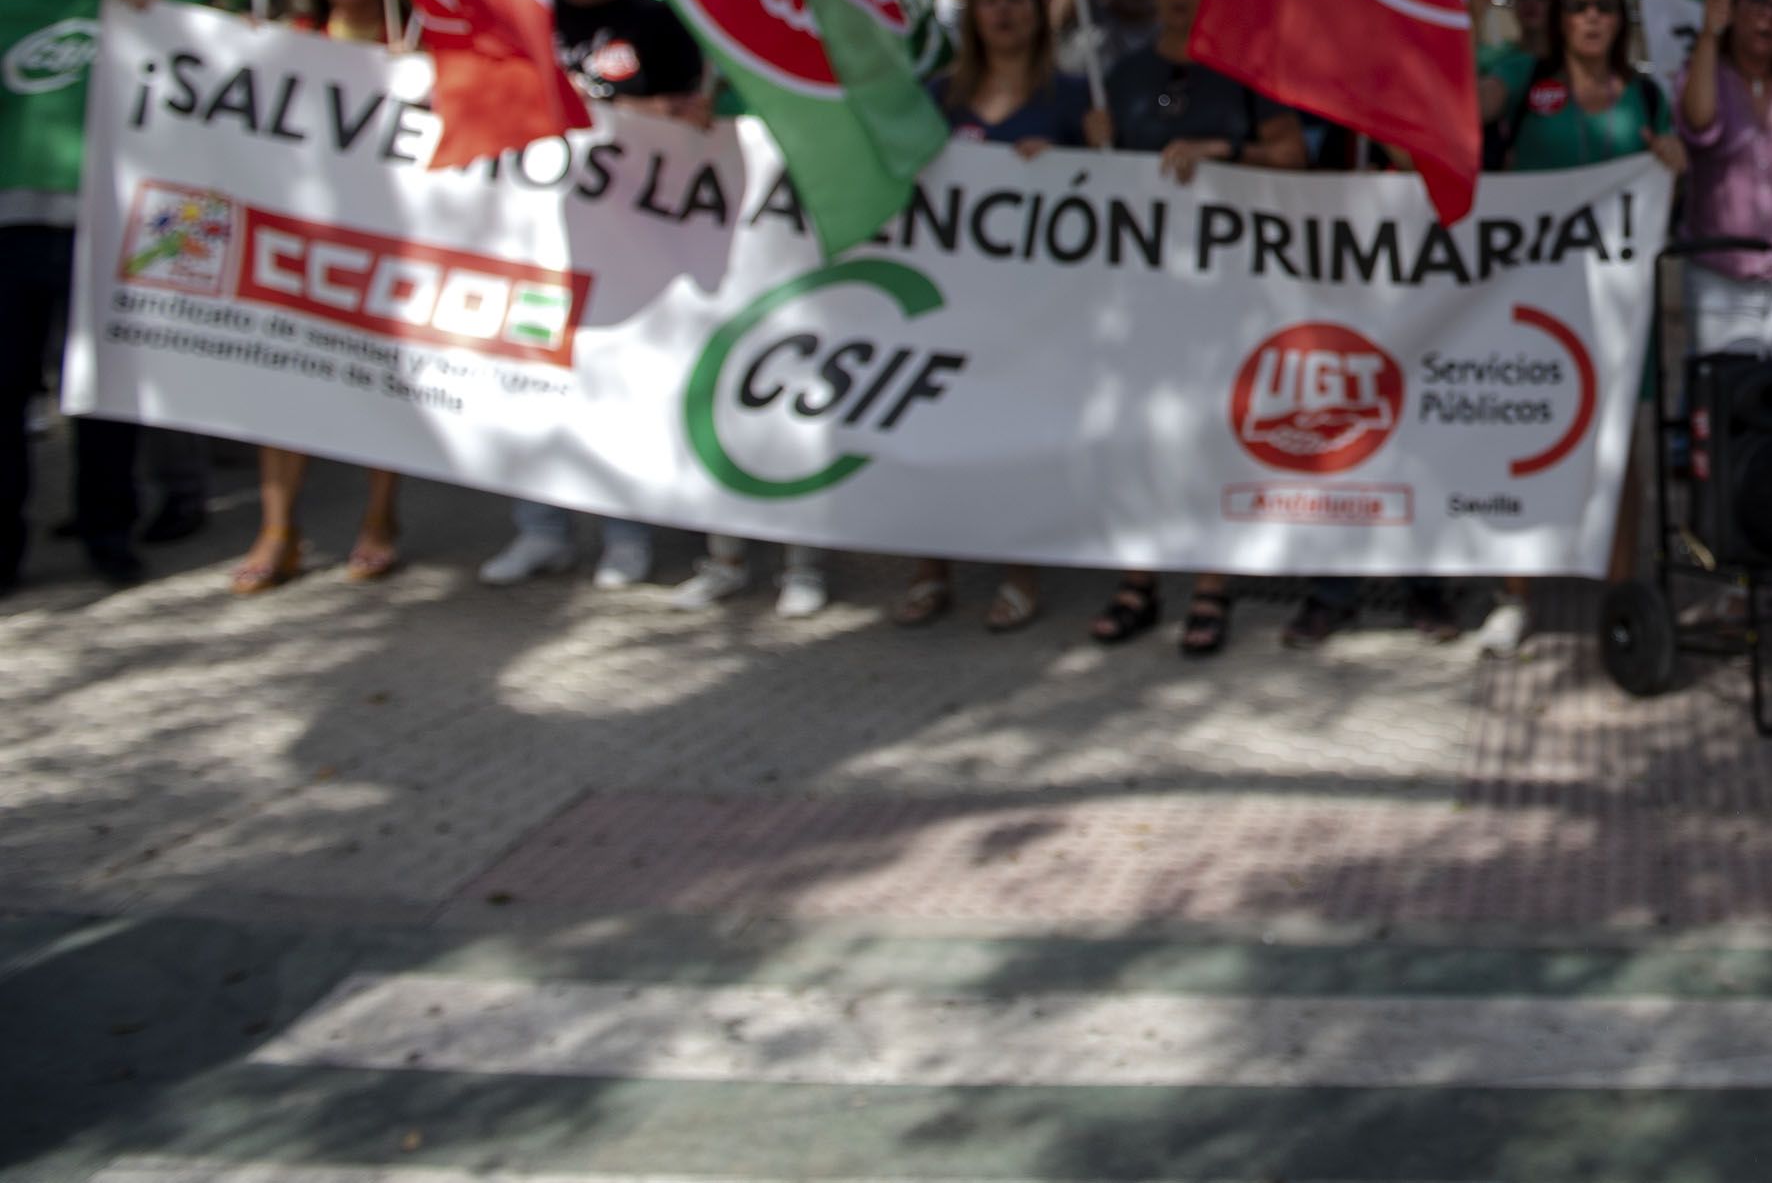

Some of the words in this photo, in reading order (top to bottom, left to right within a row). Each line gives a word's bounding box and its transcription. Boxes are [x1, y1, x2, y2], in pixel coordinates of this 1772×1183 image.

[133, 52, 622, 200] ¡SALVEOS
[637, 156, 728, 226] LA
[750, 168, 1165, 269] ANCIÓN
[1197, 191, 1635, 286] PRIMARIA!
[251, 226, 510, 340] CCOO
[734, 331, 969, 433] CSIF
[1250, 347, 1388, 417] UGT
[1420, 352, 1563, 388] Servicios
[1418, 390, 1552, 426] Públicos
[1448, 493, 1522, 518] Sevilla
